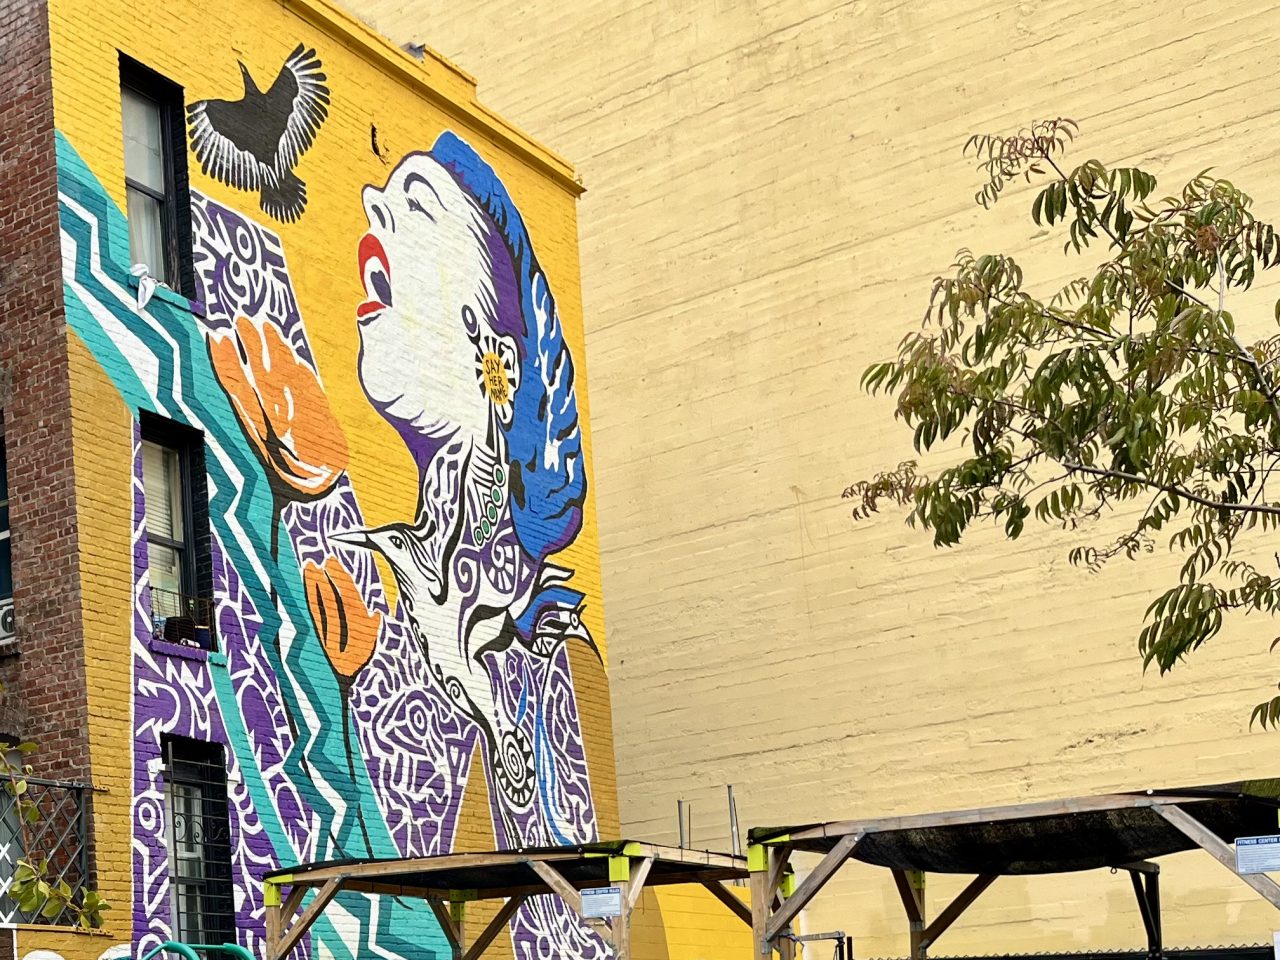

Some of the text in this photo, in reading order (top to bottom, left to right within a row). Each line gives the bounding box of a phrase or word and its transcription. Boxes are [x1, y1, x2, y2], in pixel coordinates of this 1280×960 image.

[485, 359, 501, 375] SAY
[489, 375, 504, 389] HER
[490, 388, 508, 402] NAME
